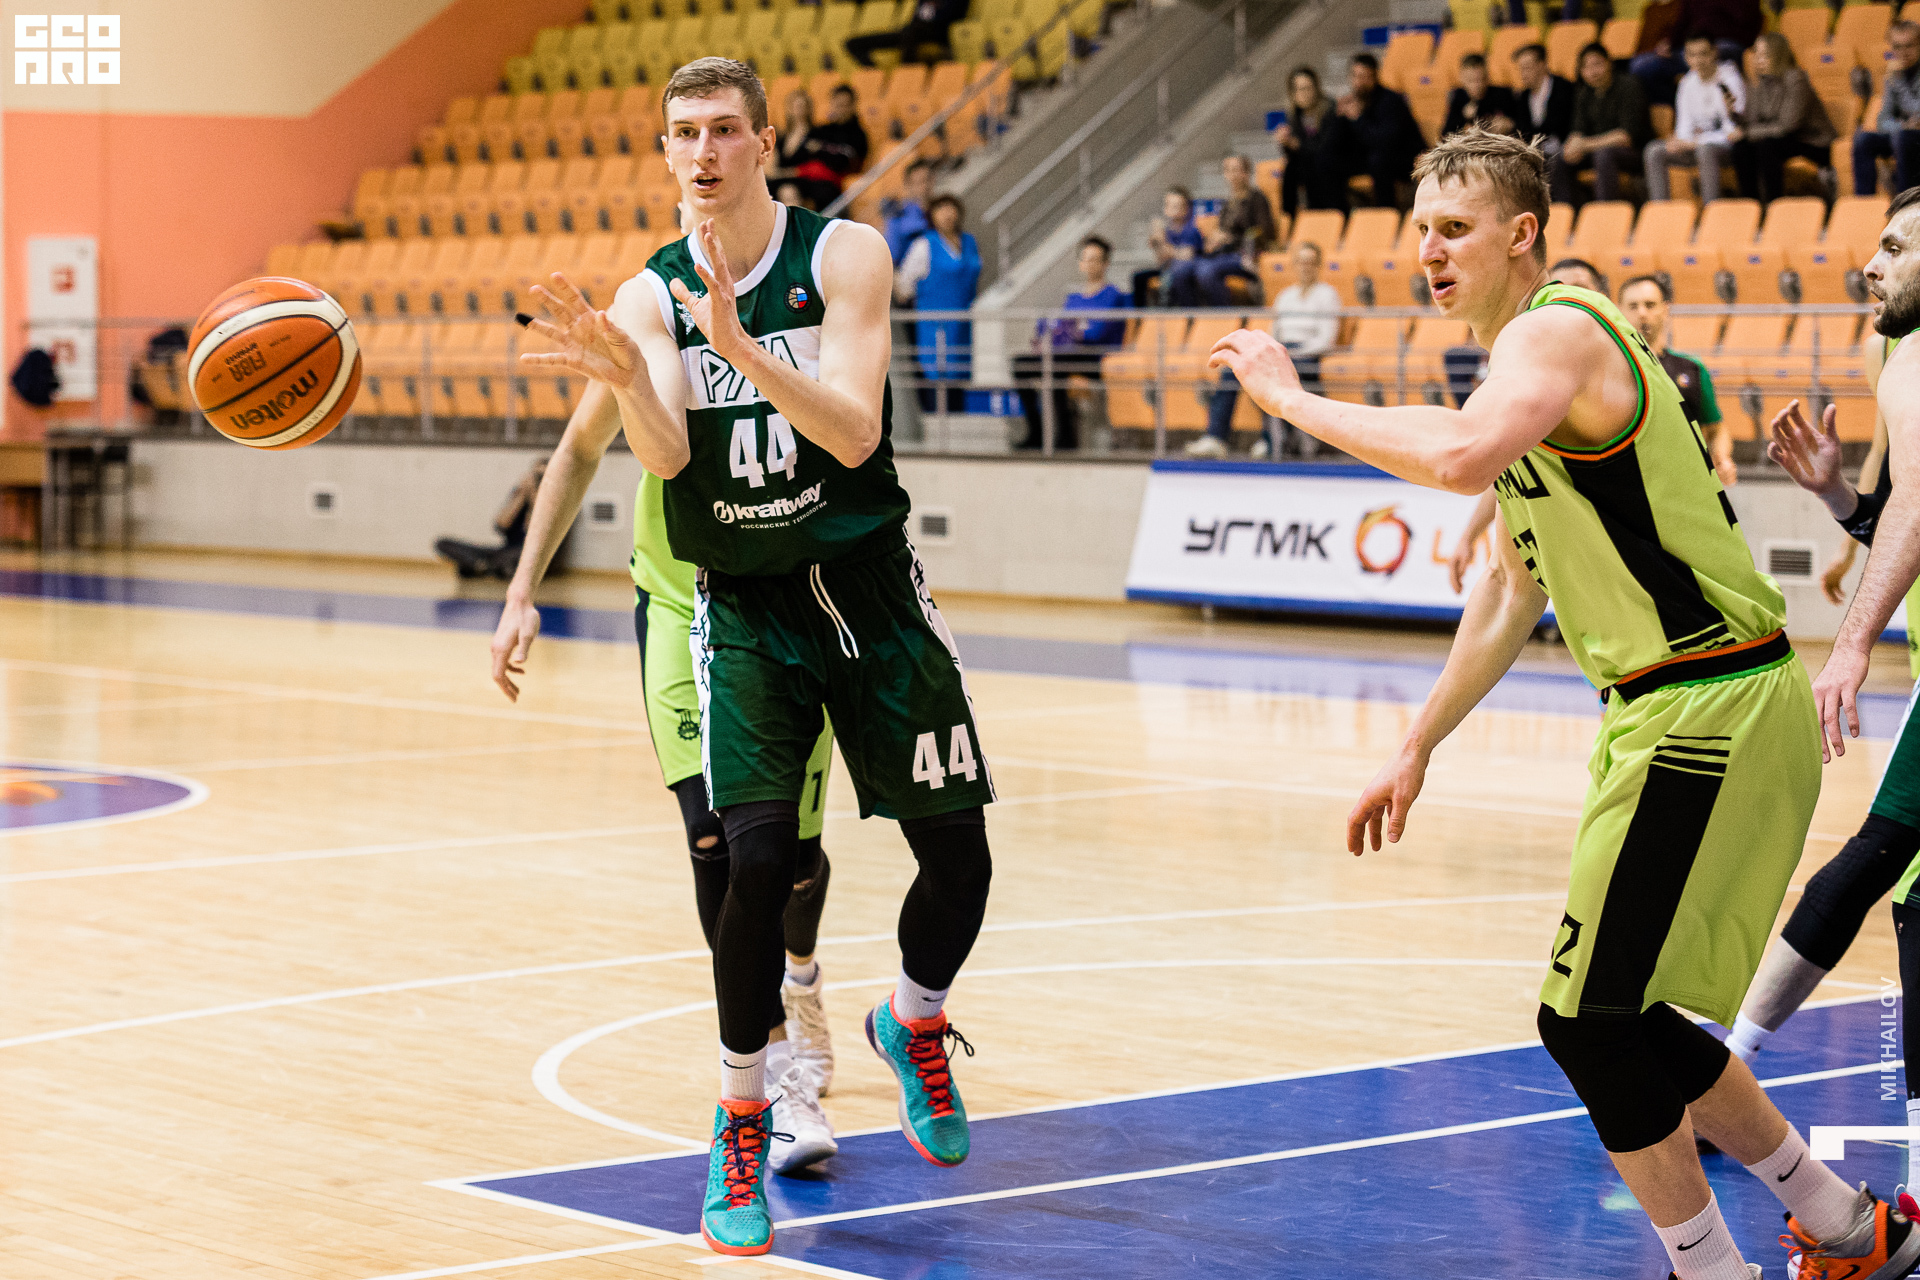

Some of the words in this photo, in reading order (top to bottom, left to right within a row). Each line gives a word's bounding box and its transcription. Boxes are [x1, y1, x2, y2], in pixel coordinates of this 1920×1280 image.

[228, 351, 266, 382] FIBA
[230, 369, 318, 430] molten
[729, 412, 798, 488] 44
[733, 482, 821, 519] kraftway
[741, 521, 790, 529] РОССИЙСКИЕ
[792, 501, 828, 524] ТЕХНОЛОГИИ
[1184, 517, 1335, 560] УГМК
[912, 723, 977, 790] 44
[1550, 910, 1584, 979] 2
